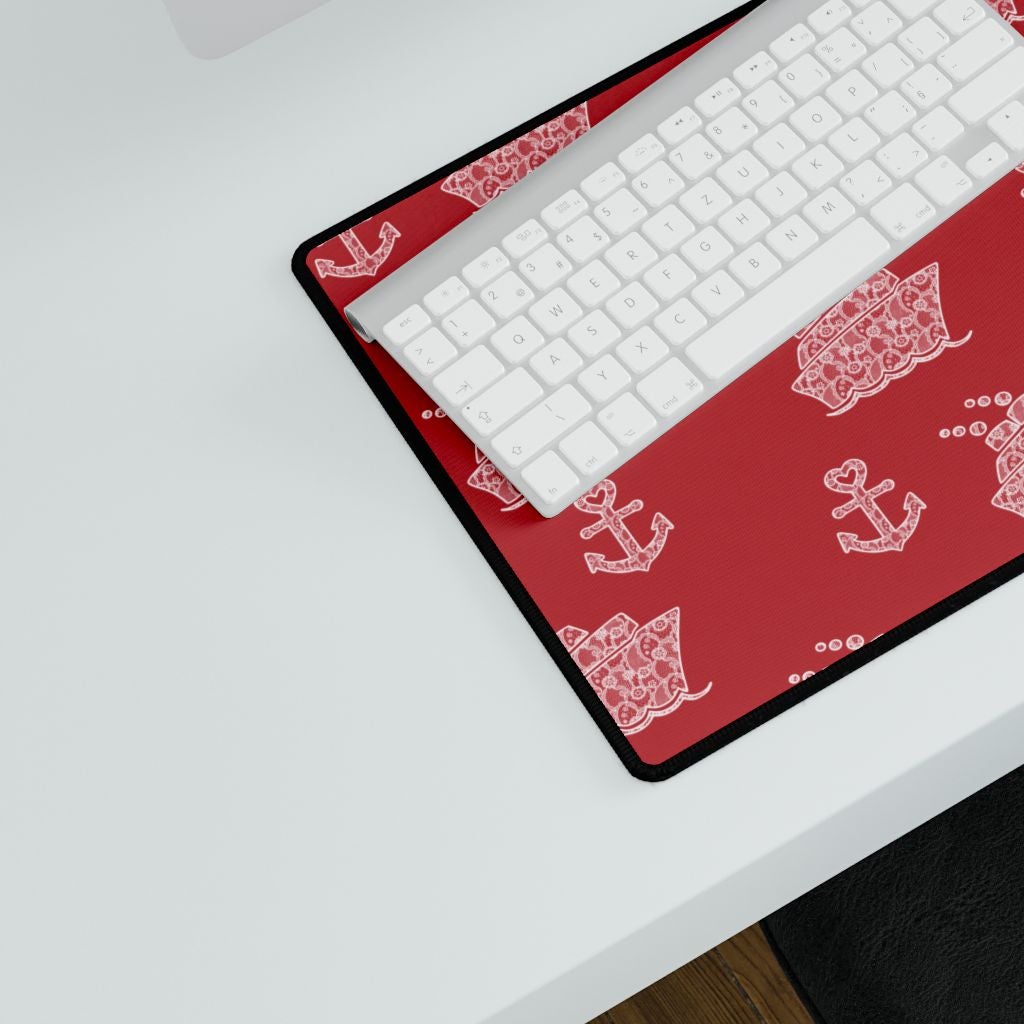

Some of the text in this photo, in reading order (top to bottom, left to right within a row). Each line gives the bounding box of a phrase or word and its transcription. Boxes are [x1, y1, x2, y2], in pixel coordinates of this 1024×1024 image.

[847, 86, 857, 97] P
[748, 98, 758, 108] 9
[712, 125, 723, 136] 8
[846, 133, 859, 143] L
[674, 151, 684, 162] 7
[703, 151, 715, 160] &
[809, 158, 823, 170] K
[736, 165, 751, 179] U
[639, 180, 649, 190] 6
[775, 186, 785, 197] J
[700, 193, 714, 207] Z
[601, 206, 612, 218] 5
[820, 201, 837, 215] M
[735, 212, 750, 225] H
[663, 221, 675, 232] T
[565, 234, 575, 244] 4
[784, 229, 799, 242] N
[698, 240, 712, 253] G
[625, 249, 639, 261] R
[525, 262, 537, 273] 3
[747, 257, 761, 270] B
[661, 268, 672, 280] F
[588, 277, 601, 289] E
[487, 290, 499, 301] 2
[710, 284, 722, 296] V
[623, 297, 636, 309] D
[548, 303, 564, 318] W
[397, 315, 413, 329] esc
[673, 312, 686, 325] C
[586, 325, 598, 337] S
[512, 334, 526, 345] Q
[635, 341, 649, 354] X
[549, 354, 561, 366] A
[596, 369, 608, 381] Y
[661, 395, 679, 410] cmd
